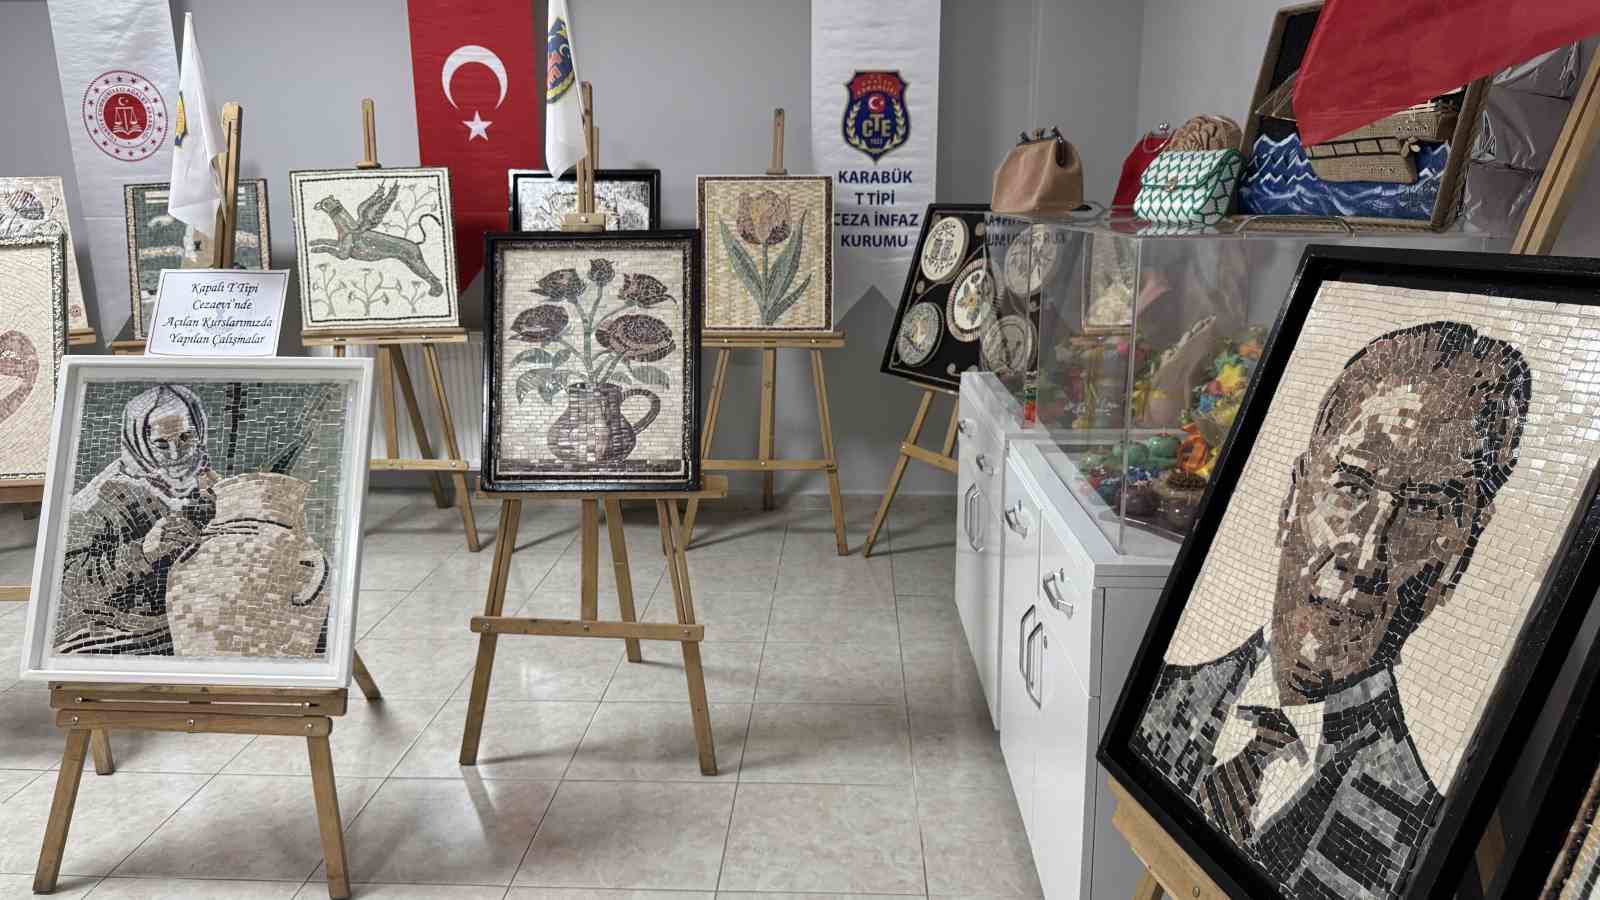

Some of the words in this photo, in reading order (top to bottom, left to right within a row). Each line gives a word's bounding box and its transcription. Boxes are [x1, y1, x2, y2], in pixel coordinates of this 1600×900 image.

[838, 168, 913, 184] KARABÜK
[855, 192, 865, 205] T
[866, 189, 895, 206] TİPİ
[874, 211, 919, 227] İNFAZ
[841, 234, 908, 248] KURUMU
[191, 281, 225, 294] Kapalı
[237, 282, 260, 296] Tipi
[162, 316, 199, 329] Açılan
[201, 316, 273, 329] Kurslarımızda
[169, 333, 209, 347] Yapılan
[212, 333, 265, 347] Çalışmalar
